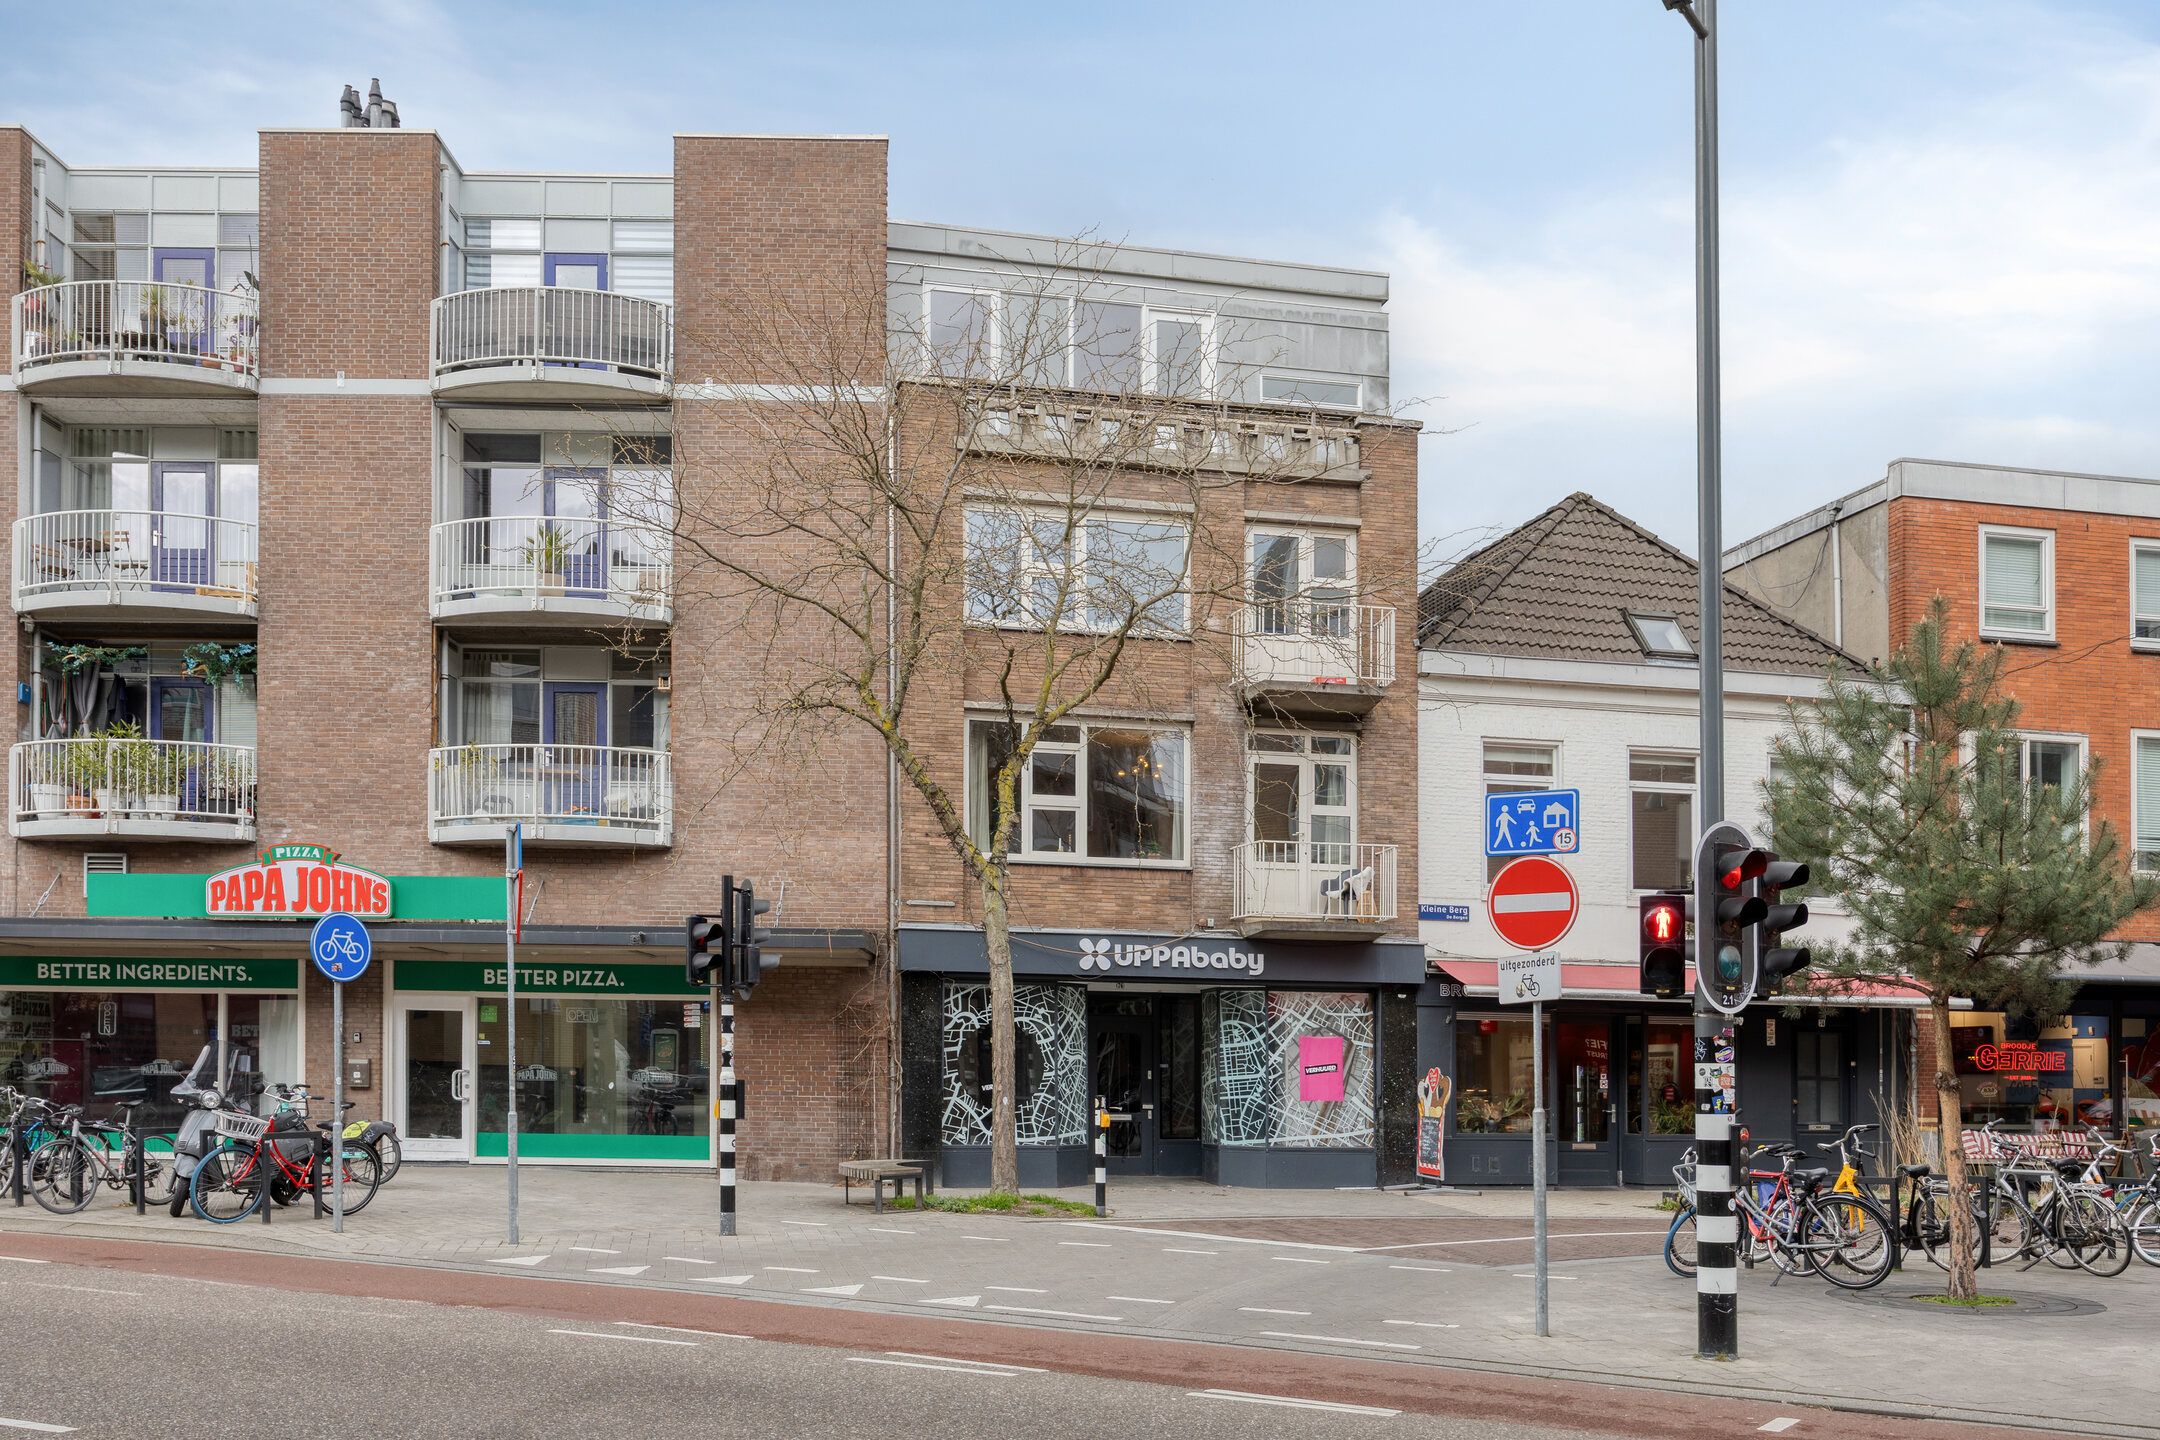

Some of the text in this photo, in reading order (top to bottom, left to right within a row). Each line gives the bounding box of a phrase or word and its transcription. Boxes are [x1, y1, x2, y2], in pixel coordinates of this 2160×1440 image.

[1557, 832, 1572, 844] 15
[275, 847, 321, 859] PIZZA
[210, 866, 387, 914] PAPA JOHN'S
[1421, 905, 1468, 916] Kleine Berg
[1114, 944, 1264, 976] UPPAbaby
[1500, 956, 1555, 972] uitgezonderd
[37, 963, 253, 982] BETTER INGREDIENTS.
[483, 968, 625, 987] BETTER PIZZA.
[1722, 995, 1734, 1005] 2.1
[22, 1001, 51, 1017] PIZZA
[567, 1009, 598, 1022] OPEN
[103, 1002, 112, 1034] OPEN
[1975, 1044, 2066, 1071] GERRIE
[28, 1063, 46, 1074] PAPA
[518, 1070, 535, 1080] PAPA
[1305, 1065, 1337, 1074] VERHUURD
[981, 1083, 994, 1092] VER
